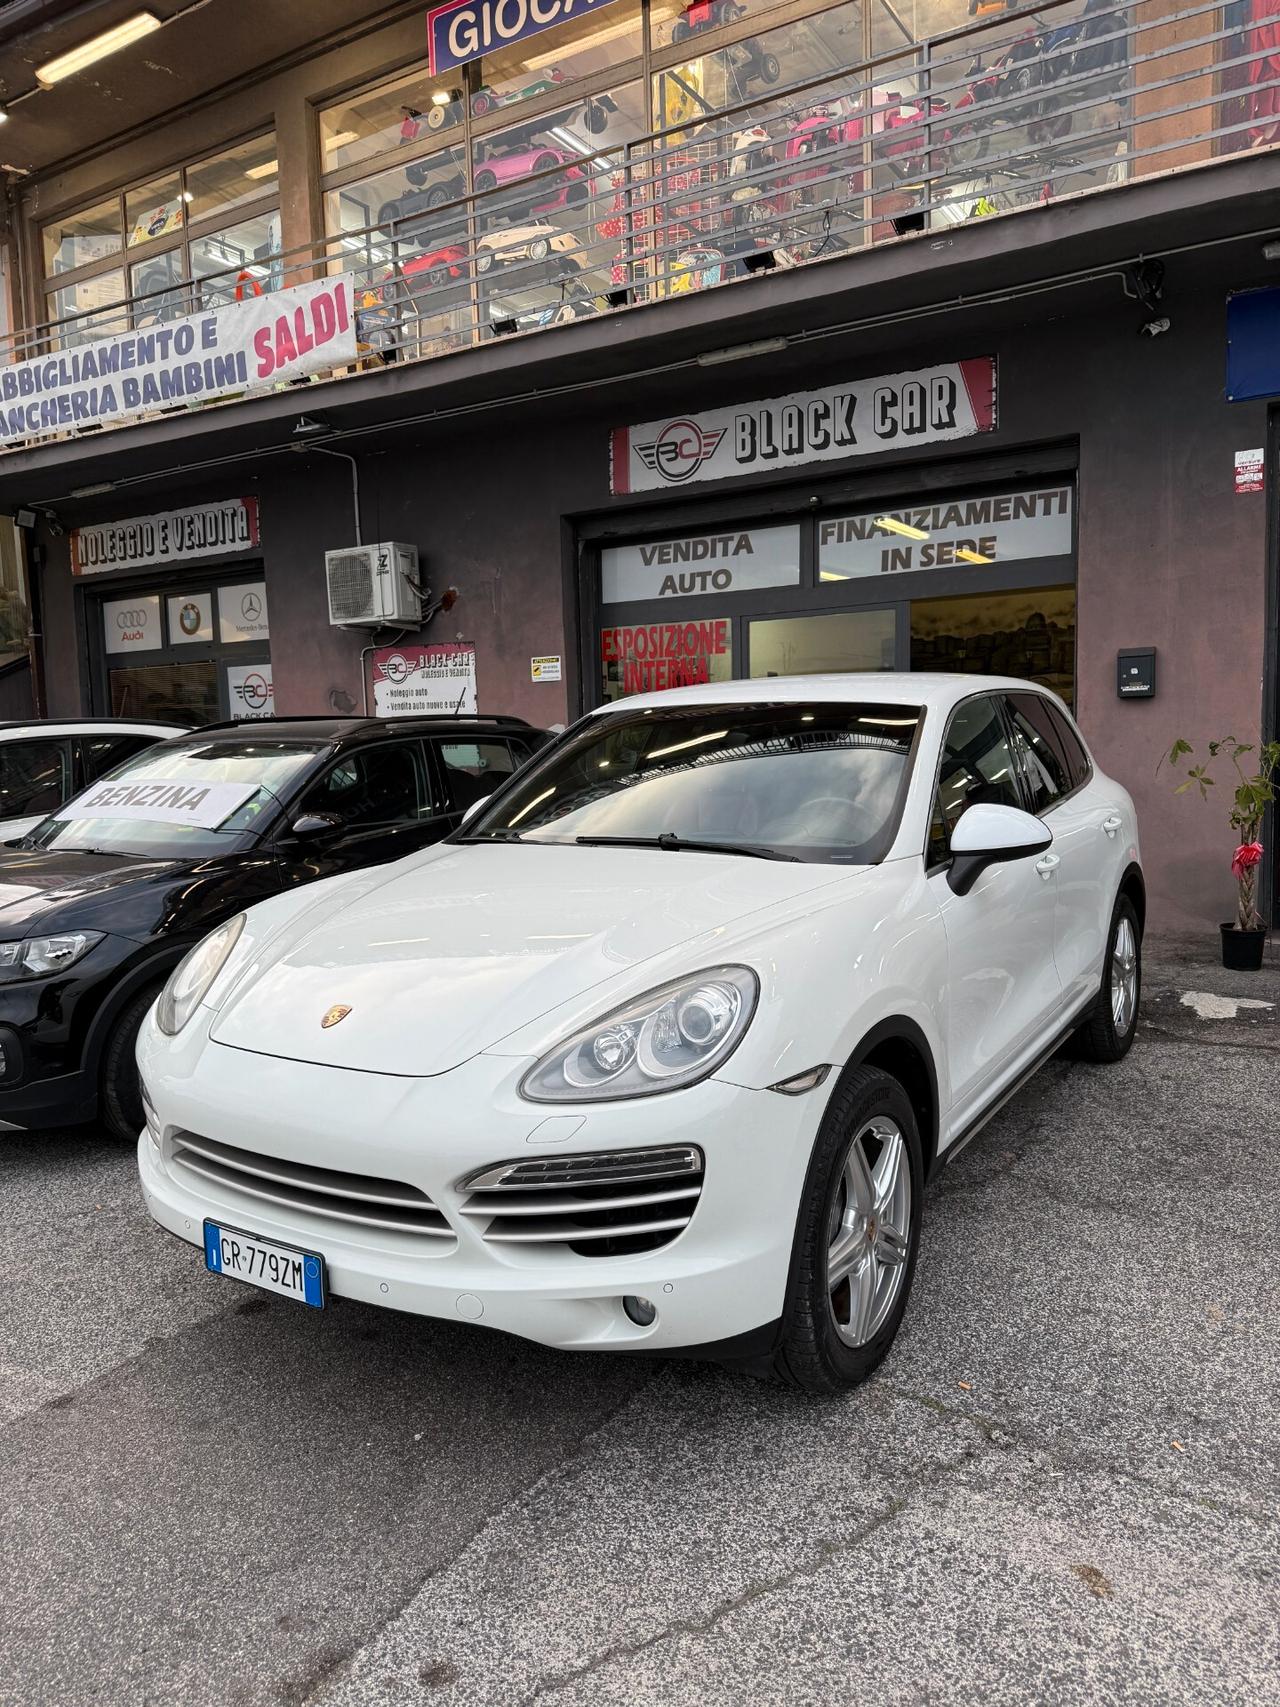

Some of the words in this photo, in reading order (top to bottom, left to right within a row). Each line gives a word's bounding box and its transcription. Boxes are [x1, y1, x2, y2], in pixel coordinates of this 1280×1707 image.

[254, 282, 350, 379] SALDI
[0, 324, 194, 402] BBIGLIAMENTO
[201, 317, 218, 350] E
[121, 351, 248, 409] BAMBINI
[734, 393, 858, 464] BLACK
[873, 376, 957, 439] CAR
[78, 522, 155, 567] NOLEGGIO
[157, 519, 169, 554] E
[171, 505, 251, 551] VENDITA
[820, 490, 1068, 546] FINANZIAMENTI
[639, 533, 754, 566] VENDITA
[881, 545, 912, 572] IN
[919, 535, 998, 568] SEDE
[658, 568, 732, 596] AUTO
[121, 631, 144, 642] Audi
[602, 620, 727, 662] ESPOSIZIONE
[419, 653, 449, 669] BLACK
[623, 656, 710, 694] INTERNA
[390, 688, 414, 698] Noleggio
[415, 687, 428, 697] auto
[391, 702, 411, 711] Vendita
[413, 701, 426, 710] auto
[444, 701, 448, 709] e
[84, 785, 211, 811] BENZINA
